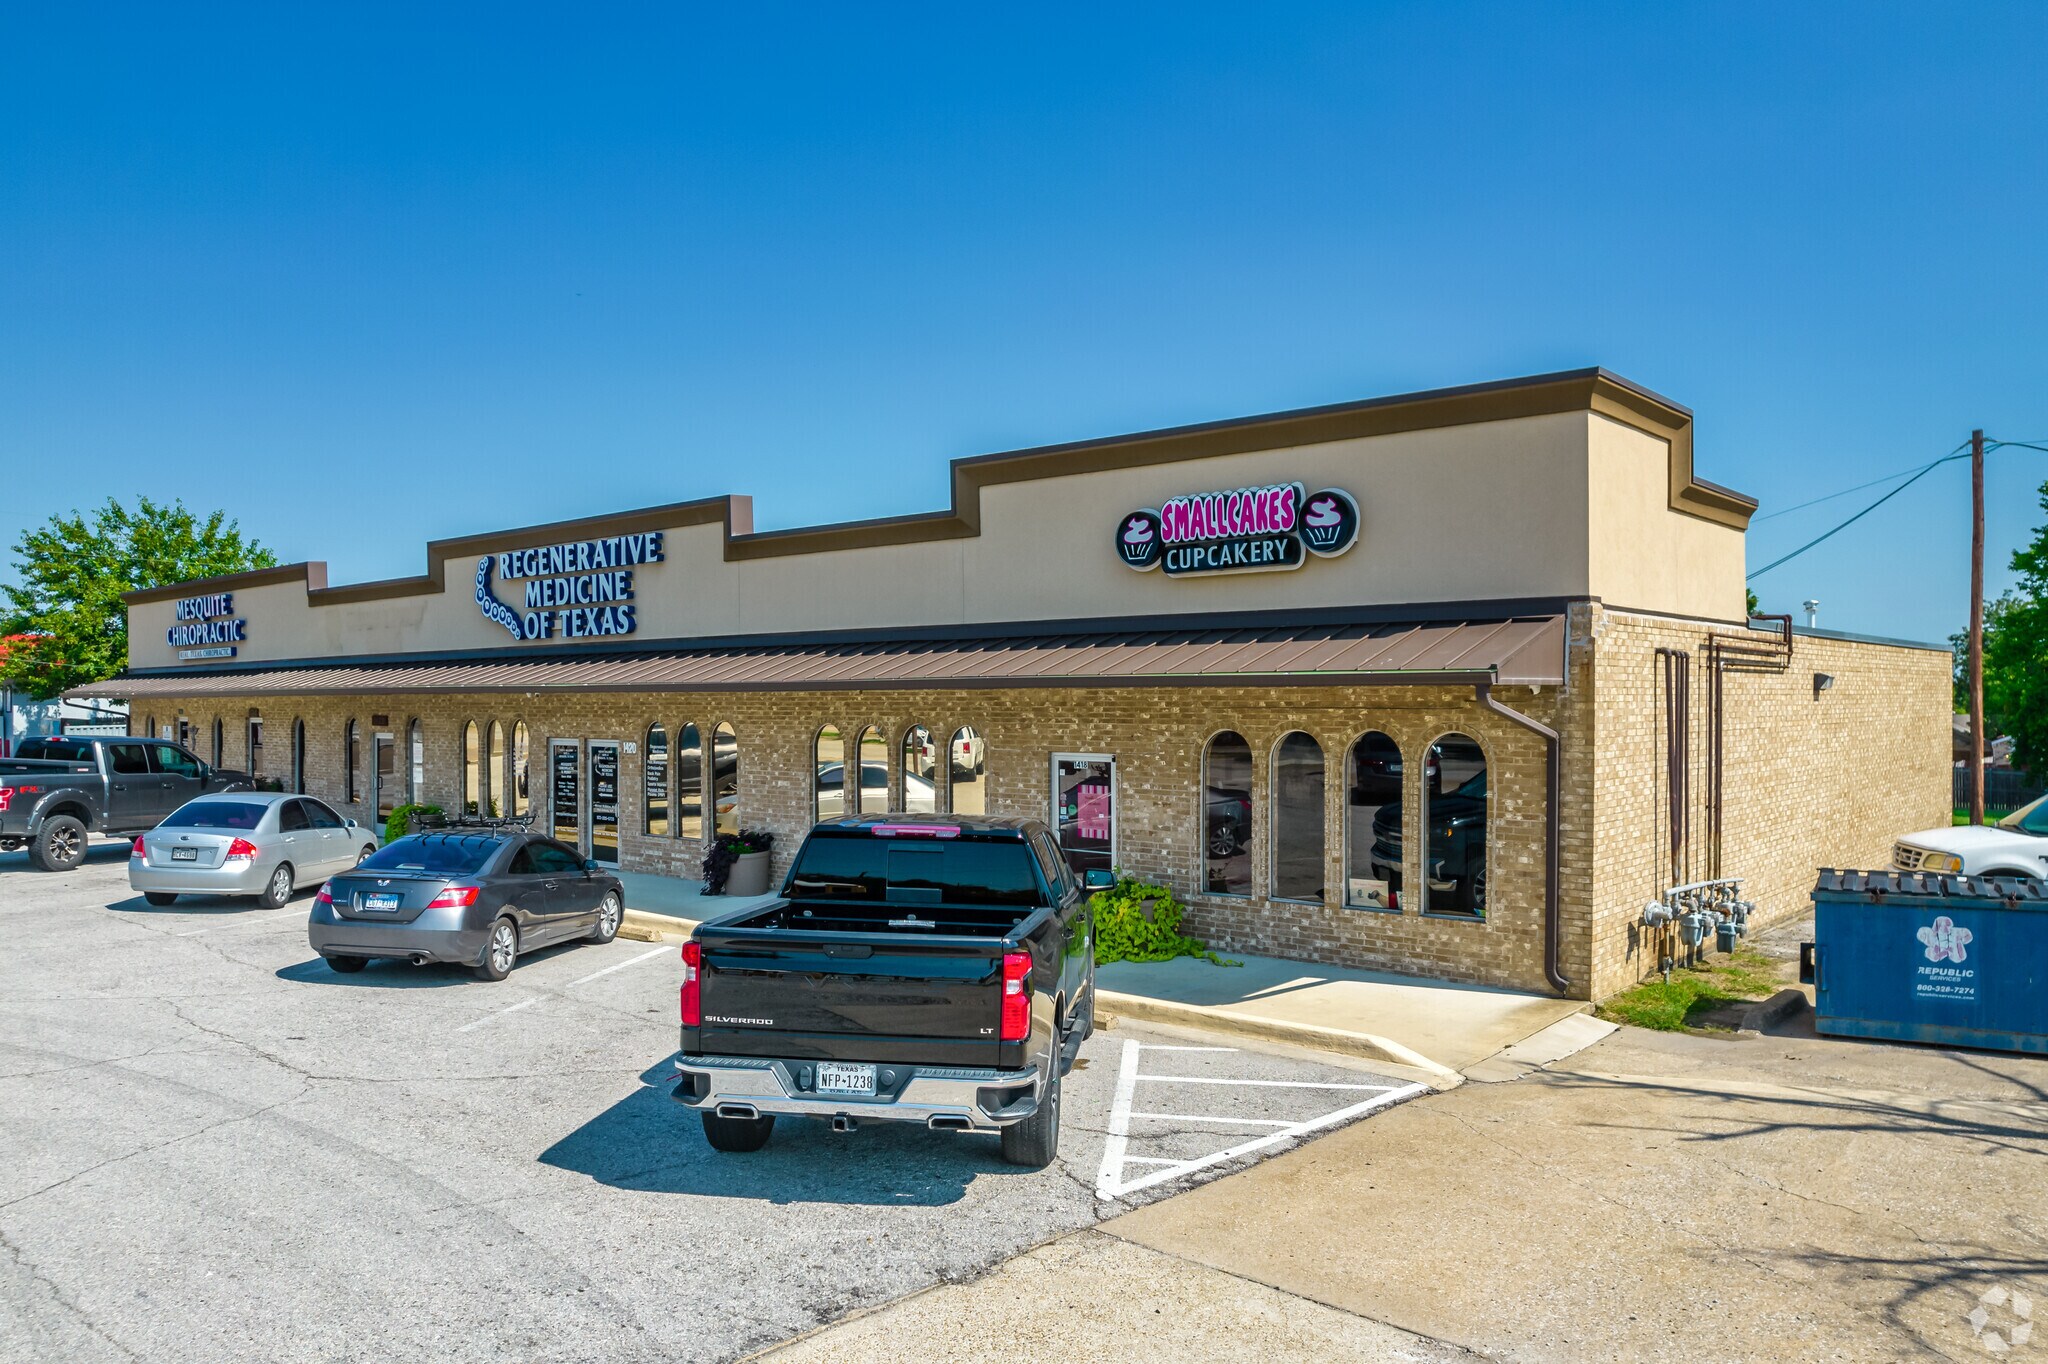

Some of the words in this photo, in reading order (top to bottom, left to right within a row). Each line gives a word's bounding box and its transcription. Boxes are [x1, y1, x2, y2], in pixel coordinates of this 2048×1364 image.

[1161, 486, 1296, 543] SMALLCAKES
[499, 532, 665, 580] REGENERATIVE
[1166, 538, 1289, 570] CUPCAKERY
[525, 571, 634, 608] MEDICINE
[176, 593, 233, 622] MESQUITE
[166, 619, 246, 647] CHIROPRACTIC
[524, 611, 555, 640] OF
[558, 605, 636, 638] TEXAS
[623, 742, 637, 754] 1420
[1074, 761, 1088, 769] 1418
[1917, 966, 1974, 978] REPUBLIC
[1929, 975, 1962, 983] SERVICES
[705, 1015, 773, 1025] SILVERADO
